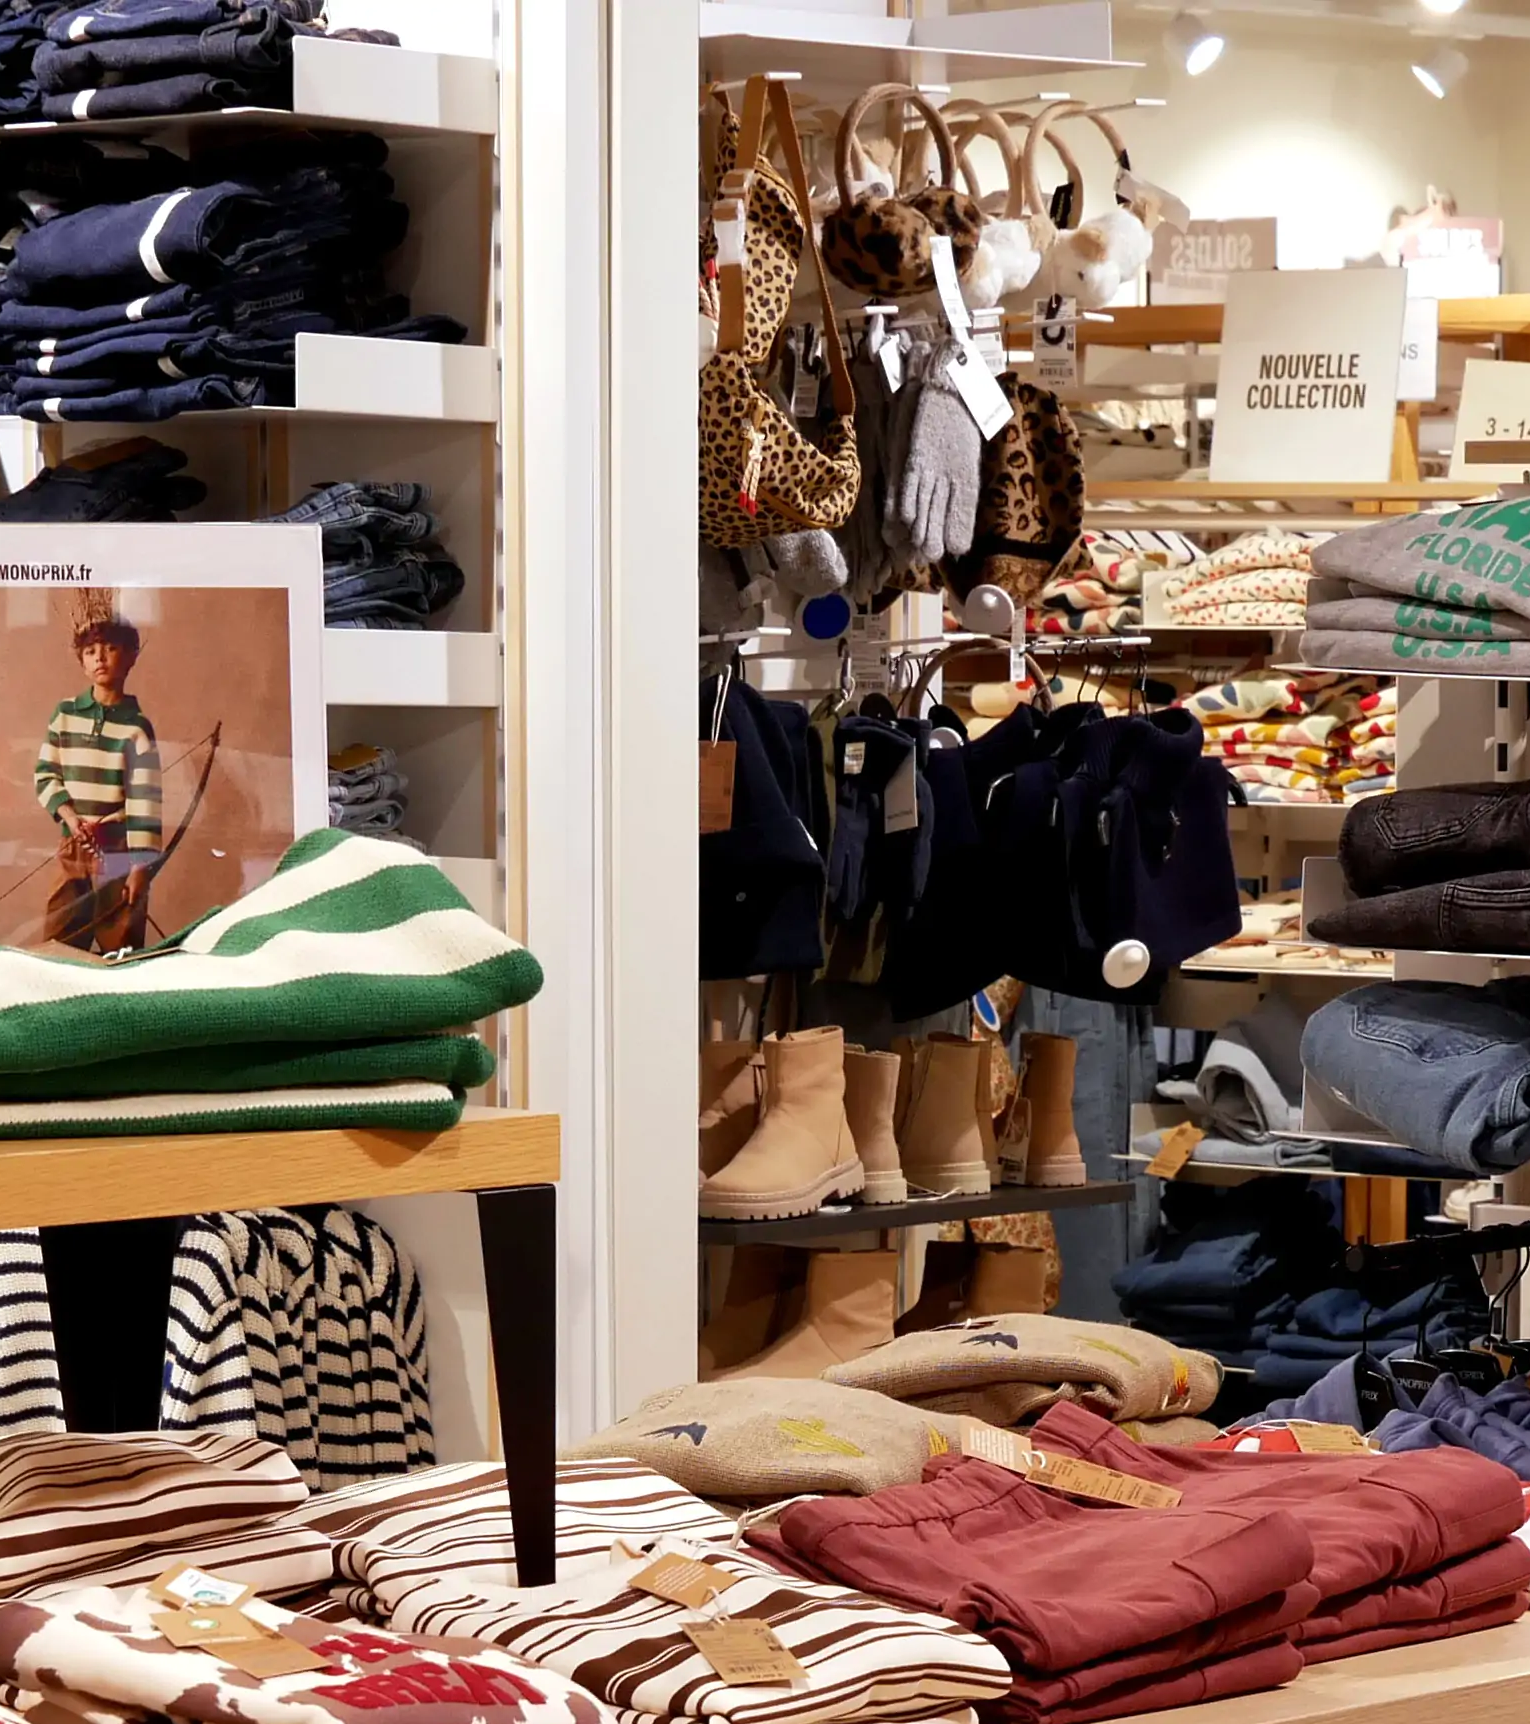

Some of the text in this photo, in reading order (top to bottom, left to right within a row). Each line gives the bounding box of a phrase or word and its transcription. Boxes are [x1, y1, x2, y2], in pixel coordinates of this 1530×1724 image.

[1259, 354, 1360, 380] NOUVELLE
[1246, 384, 1366, 410] COLLECTION
[1485, 417, 1497, 436] 3
